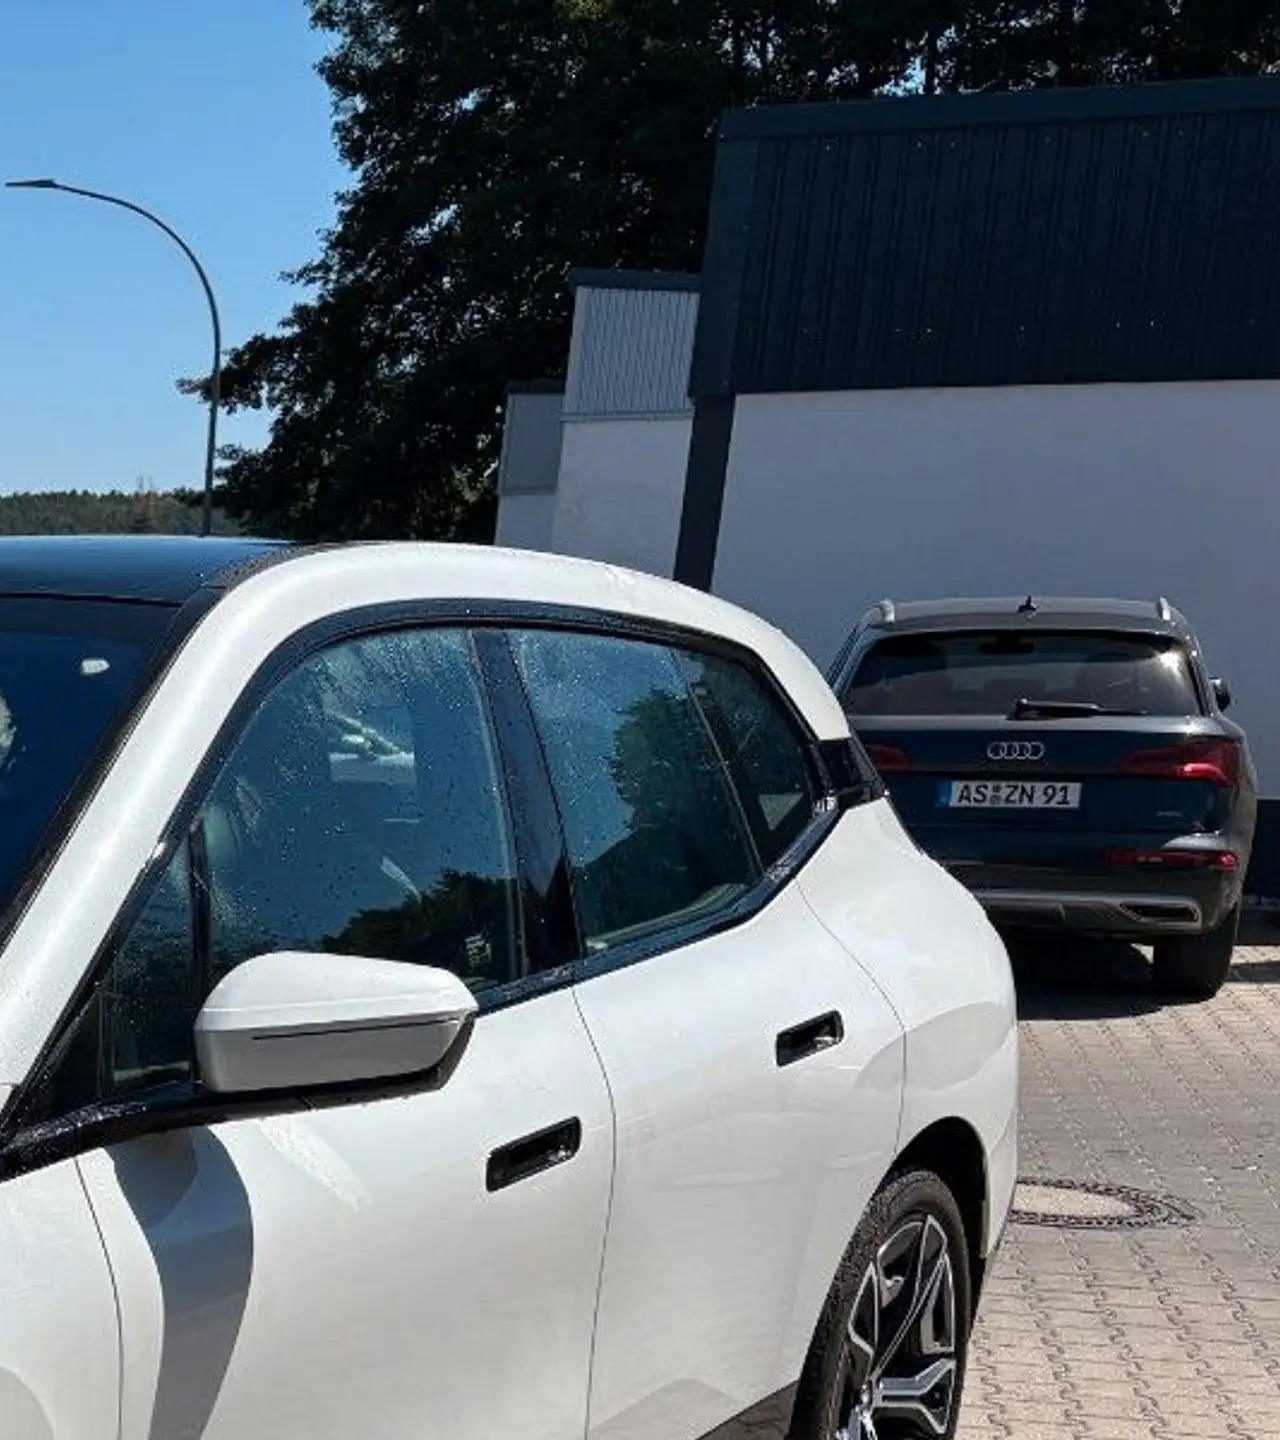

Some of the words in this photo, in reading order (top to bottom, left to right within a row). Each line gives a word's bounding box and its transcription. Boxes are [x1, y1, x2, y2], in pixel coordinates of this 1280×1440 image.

[957, 784, 989, 804] AS
[1003, 784, 1036, 804] ZN
[1042, 785, 1071, 806] 91
